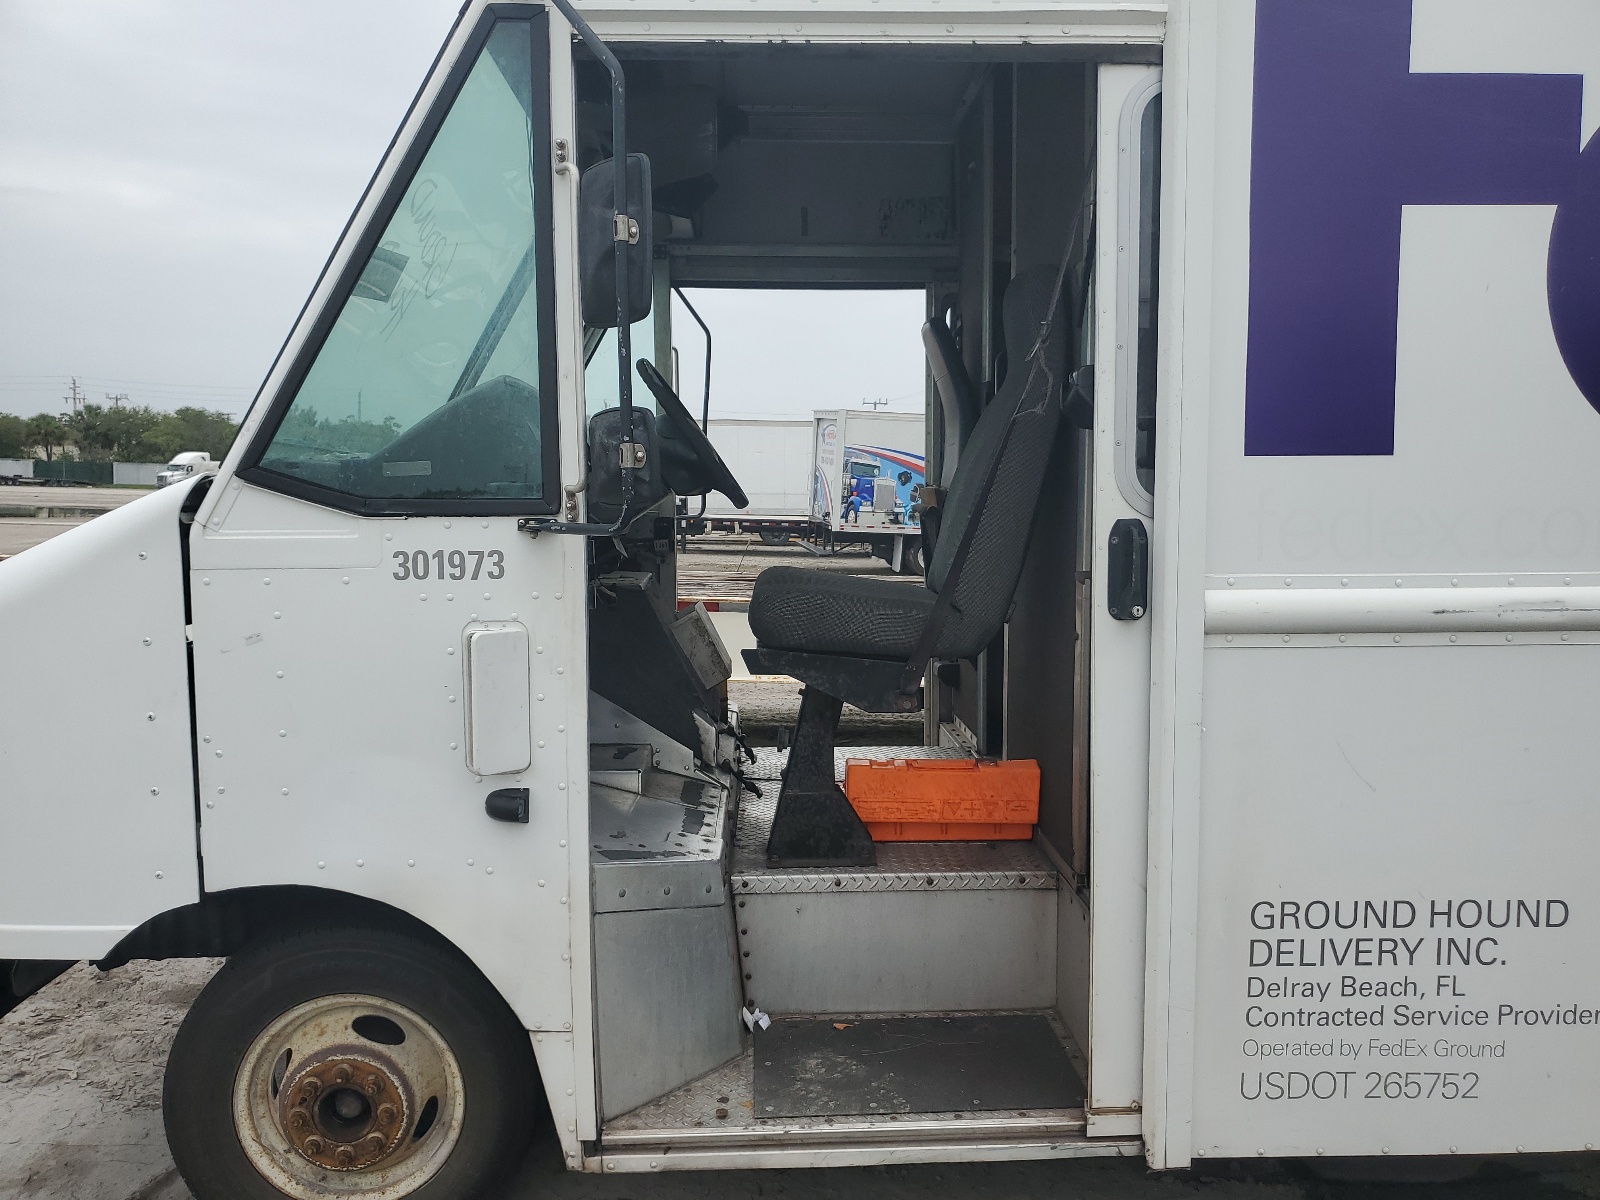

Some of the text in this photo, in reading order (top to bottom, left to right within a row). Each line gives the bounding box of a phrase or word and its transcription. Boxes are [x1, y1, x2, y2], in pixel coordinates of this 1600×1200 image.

[392, 549, 505, 581] 301973
[1250, 898, 1570, 930] GROUND HOUND
[1248, 936, 1507, 968] DELIVERY INC.
[1246, 974, 1466, 1003] Delray Beach, FL
[1245, 1004, 1385, 1028] Contracted
[1393, 1003, 1489, 1027] Service
[1242, 1038, 1506, 1061] Operated by FedEx Ground
[1240, 1070, 1480, 1101] USDOT 265752
